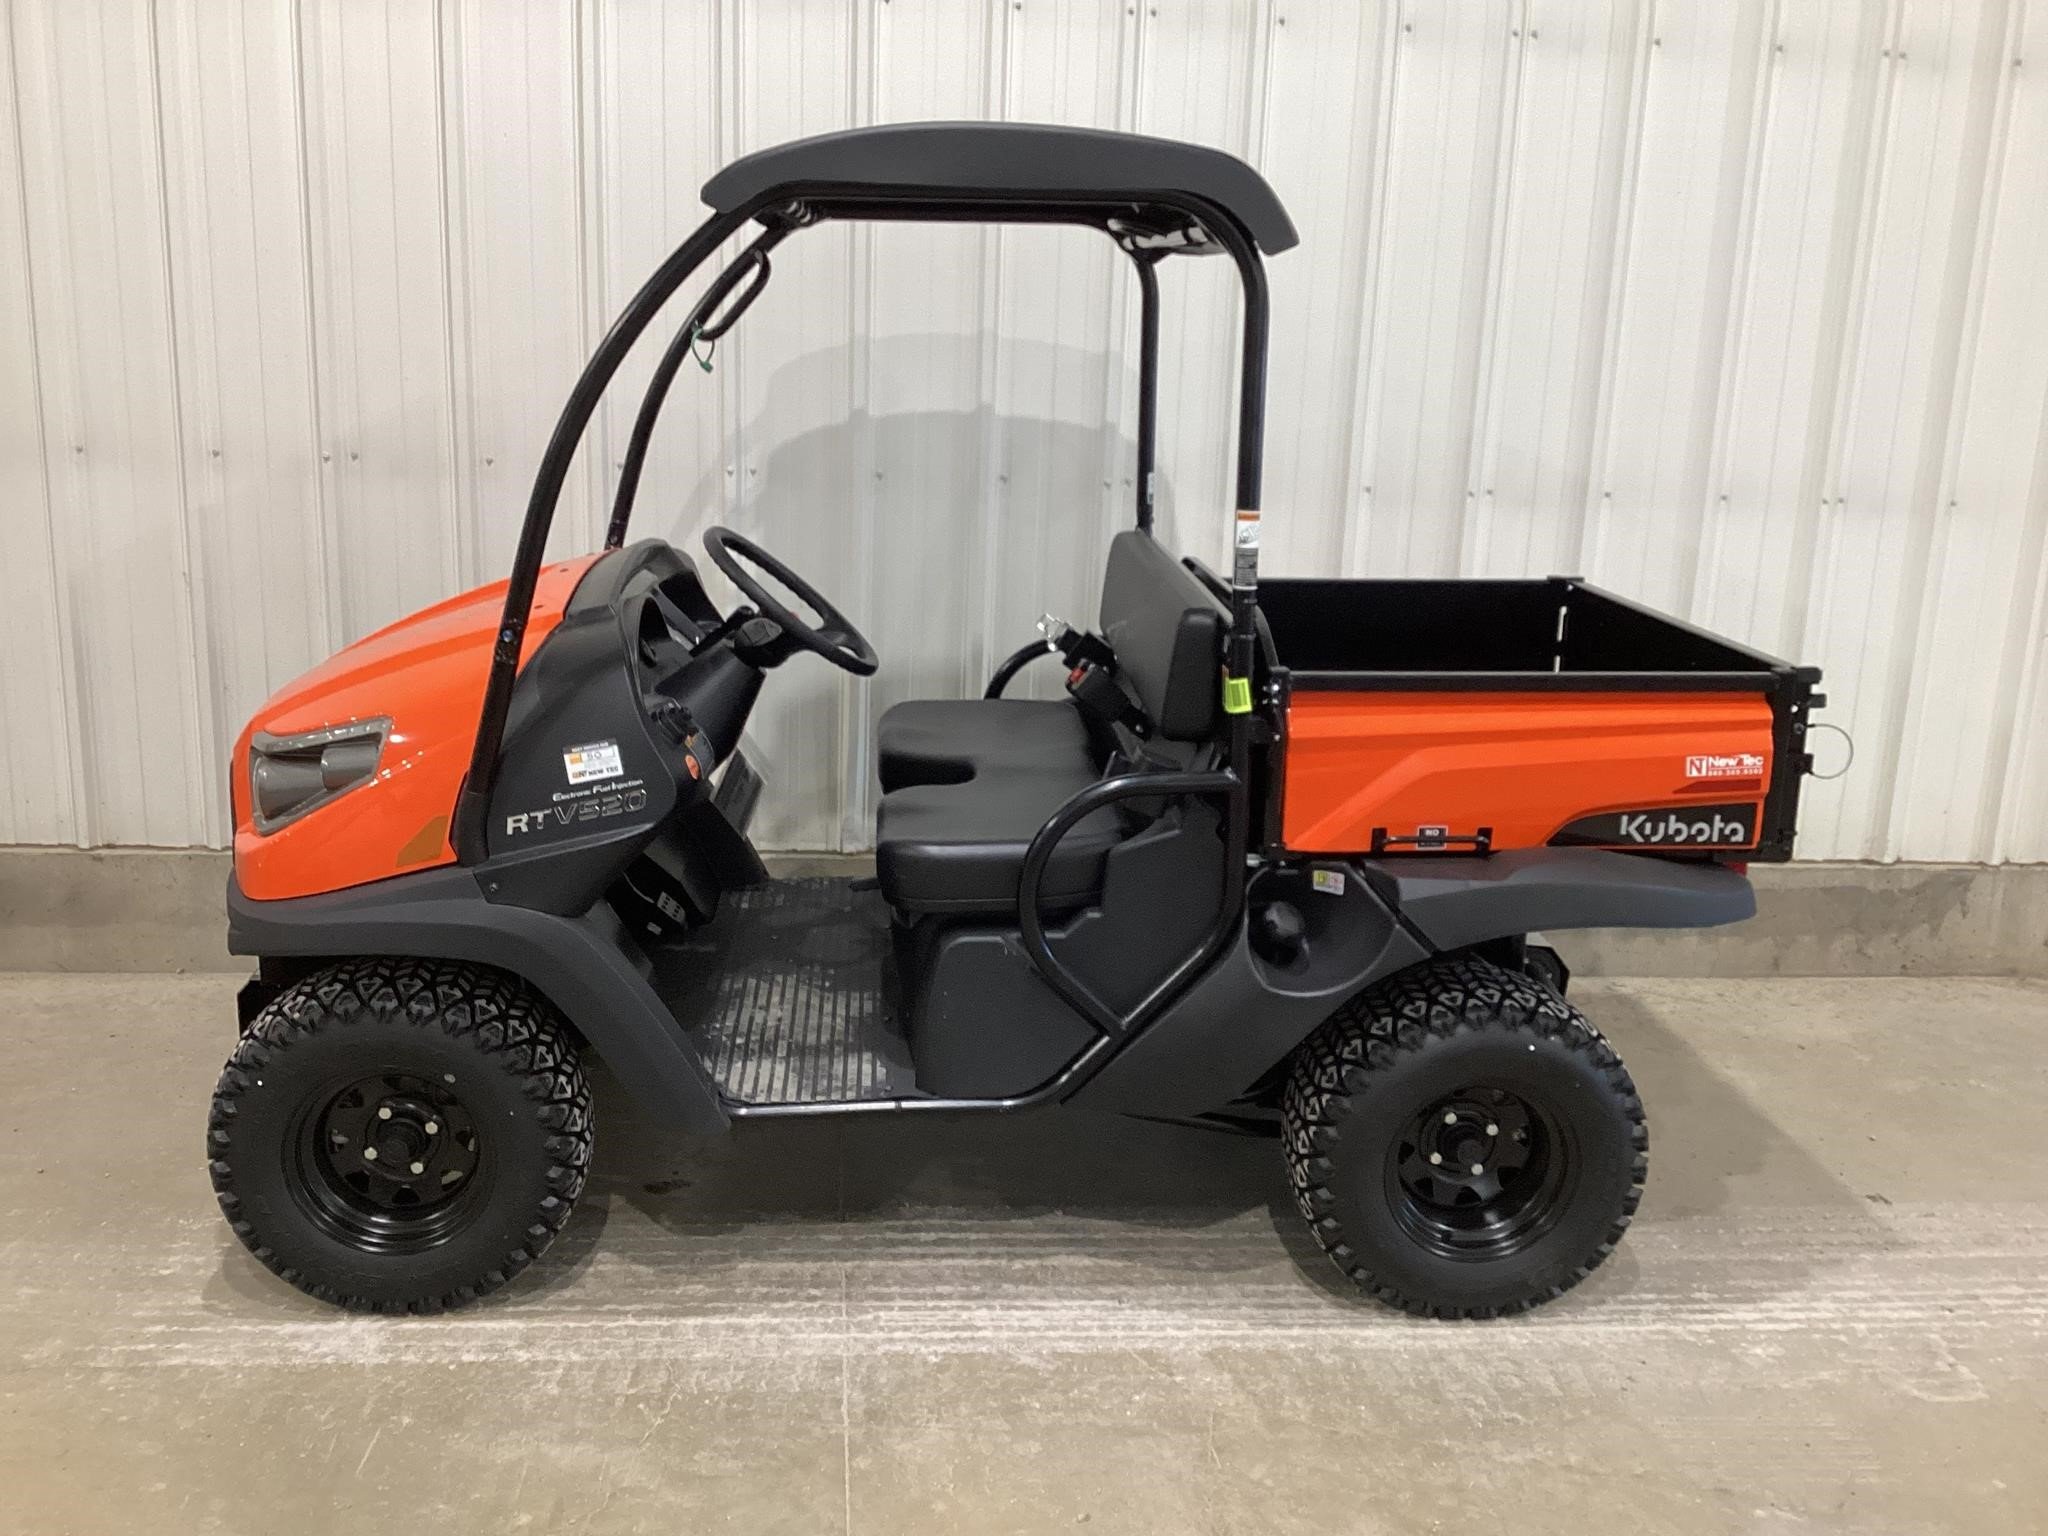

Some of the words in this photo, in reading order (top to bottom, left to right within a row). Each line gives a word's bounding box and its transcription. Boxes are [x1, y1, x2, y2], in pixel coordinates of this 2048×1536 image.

[1709, 756, 1739, 767] New
[1741, 754, 1764, 767] Tec
[552, 788, 591, 802] Electronic
[592, 784, 611, 794] Fuel
[612, 779, 644, 791] Injection
[506, 788, 647, 835] RTV520
[1619, 814, 1746, 843] Kubota
